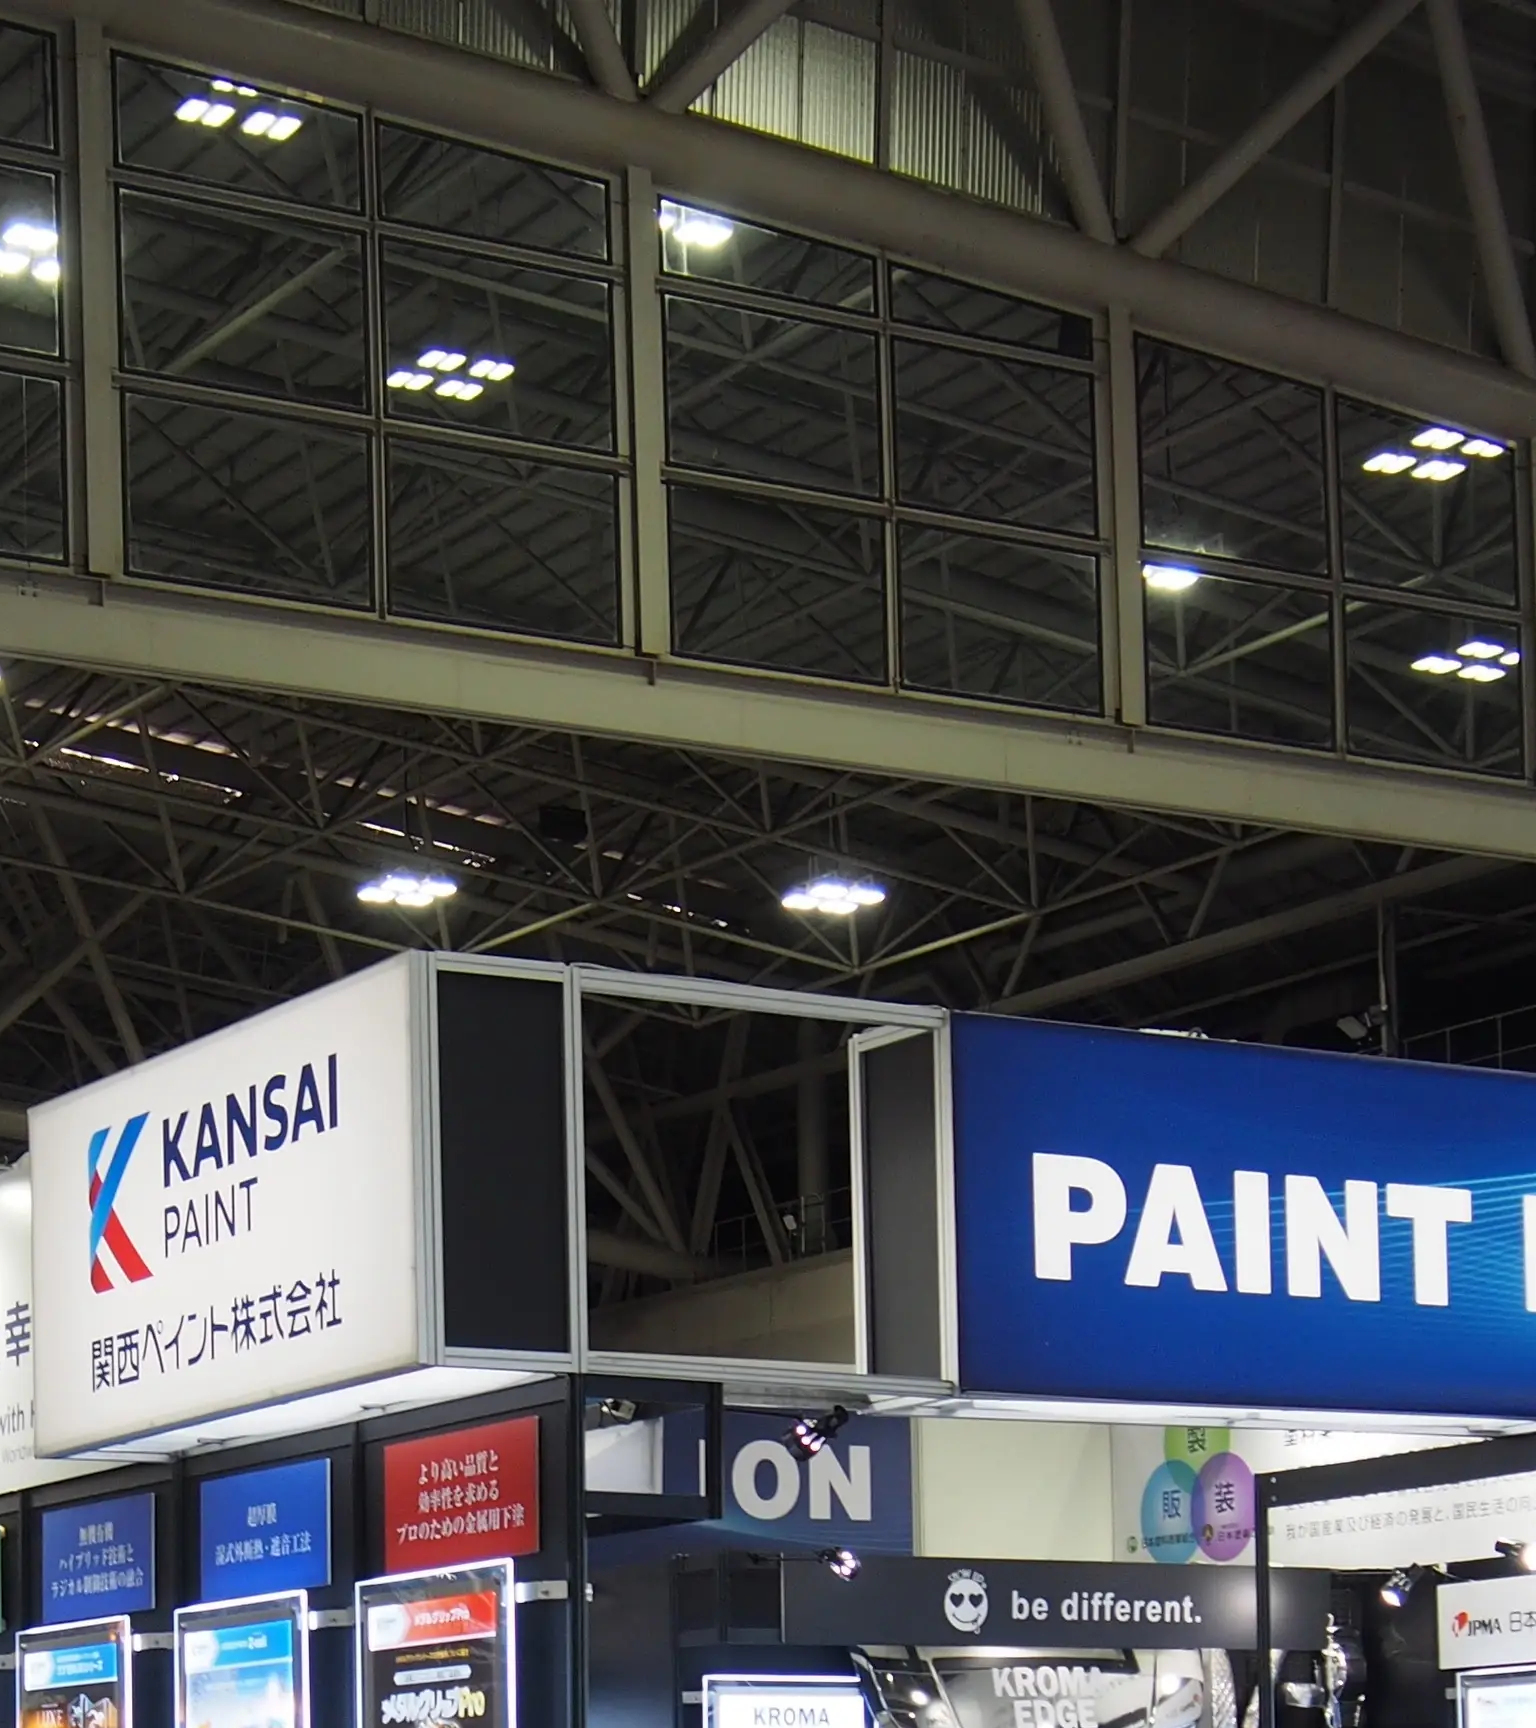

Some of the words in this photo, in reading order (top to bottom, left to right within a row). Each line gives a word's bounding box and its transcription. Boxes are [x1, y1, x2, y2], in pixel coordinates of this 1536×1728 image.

[162, 1053, 339, 1188] KANSAI
[164, 1177, 259, 1258] PAINT
[1032, 1152, 1473, 1307] PAINT
[90, 1268, 342, 1393] 関西ペイント株式会社
[417, 1450, 500, 1485] より高い品質と
[699, 1439, 872, 1521] ON
[417, 1479, 500, 1514] 効率性を求める
[396, 1503, 525, 1545] プロのための金属用下塗
[1011, 1590, 1049, 1621] be
[1061, 1591, 1202, 1625] different.
[991, 1666, 1102, 1698] KROMA
[753, 1707, 831, 1726] KROMA
